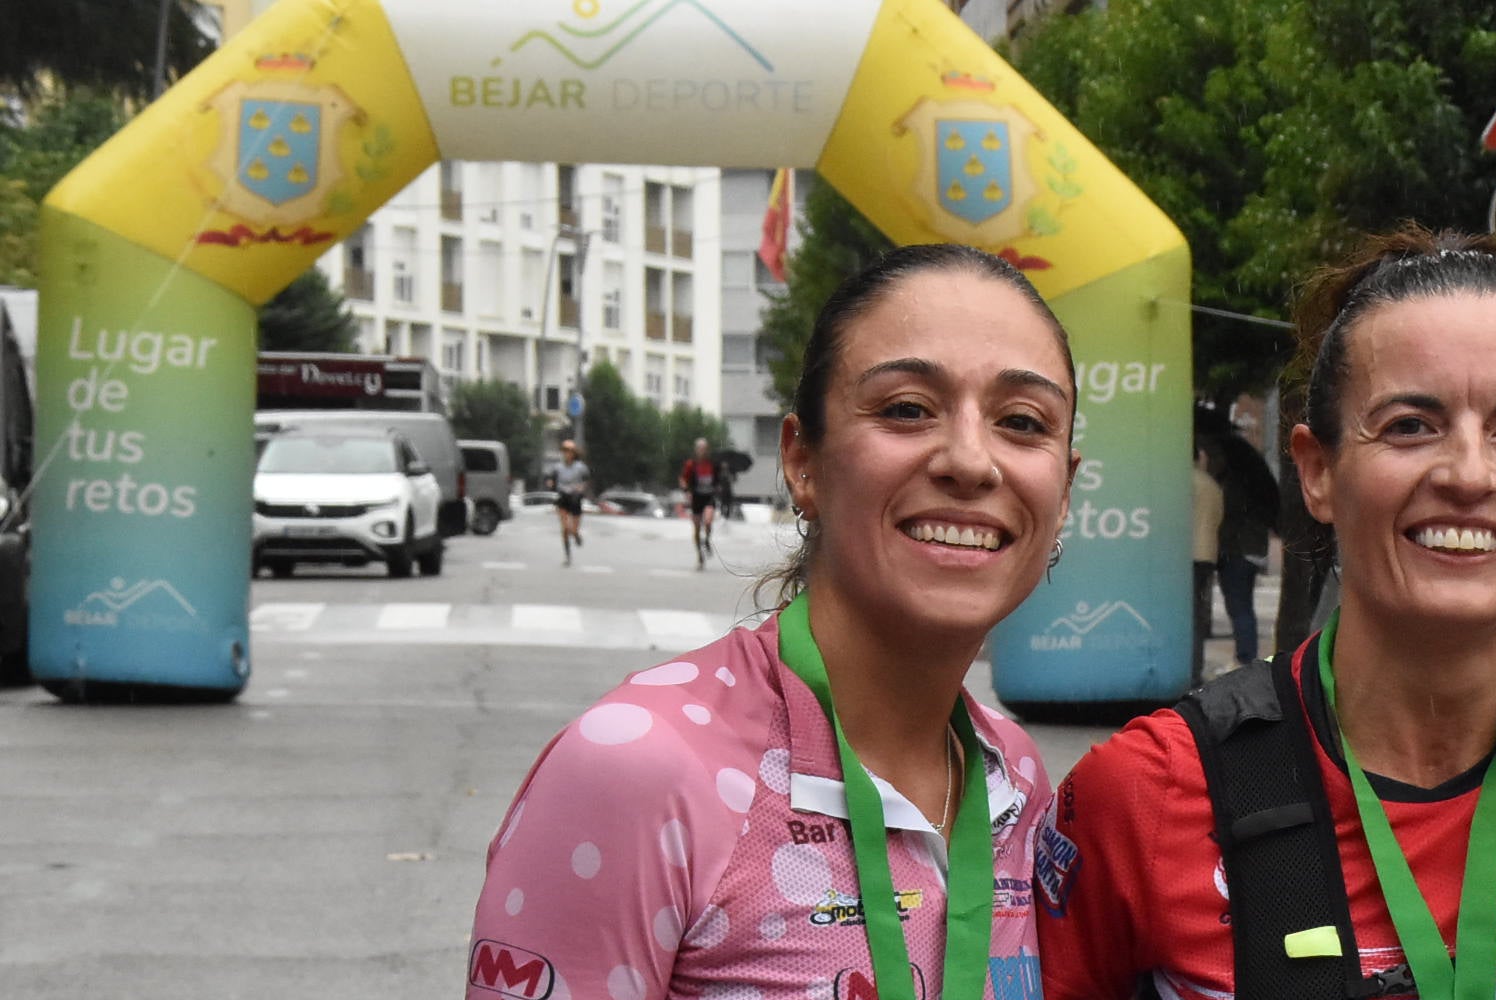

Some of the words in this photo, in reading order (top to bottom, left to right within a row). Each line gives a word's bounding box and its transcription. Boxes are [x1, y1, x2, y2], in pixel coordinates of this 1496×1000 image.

[448, 58, 587, 110] BÉJAR
[610, 77, 815, 114] DEPORTE
[68, 316, 218, 374] Lugar
[66, 366, 129, 412] de
[66, 418, 145, 464] tus
[66, 472, 197, 518] retos
[787, 820, 837, 845] Bar
